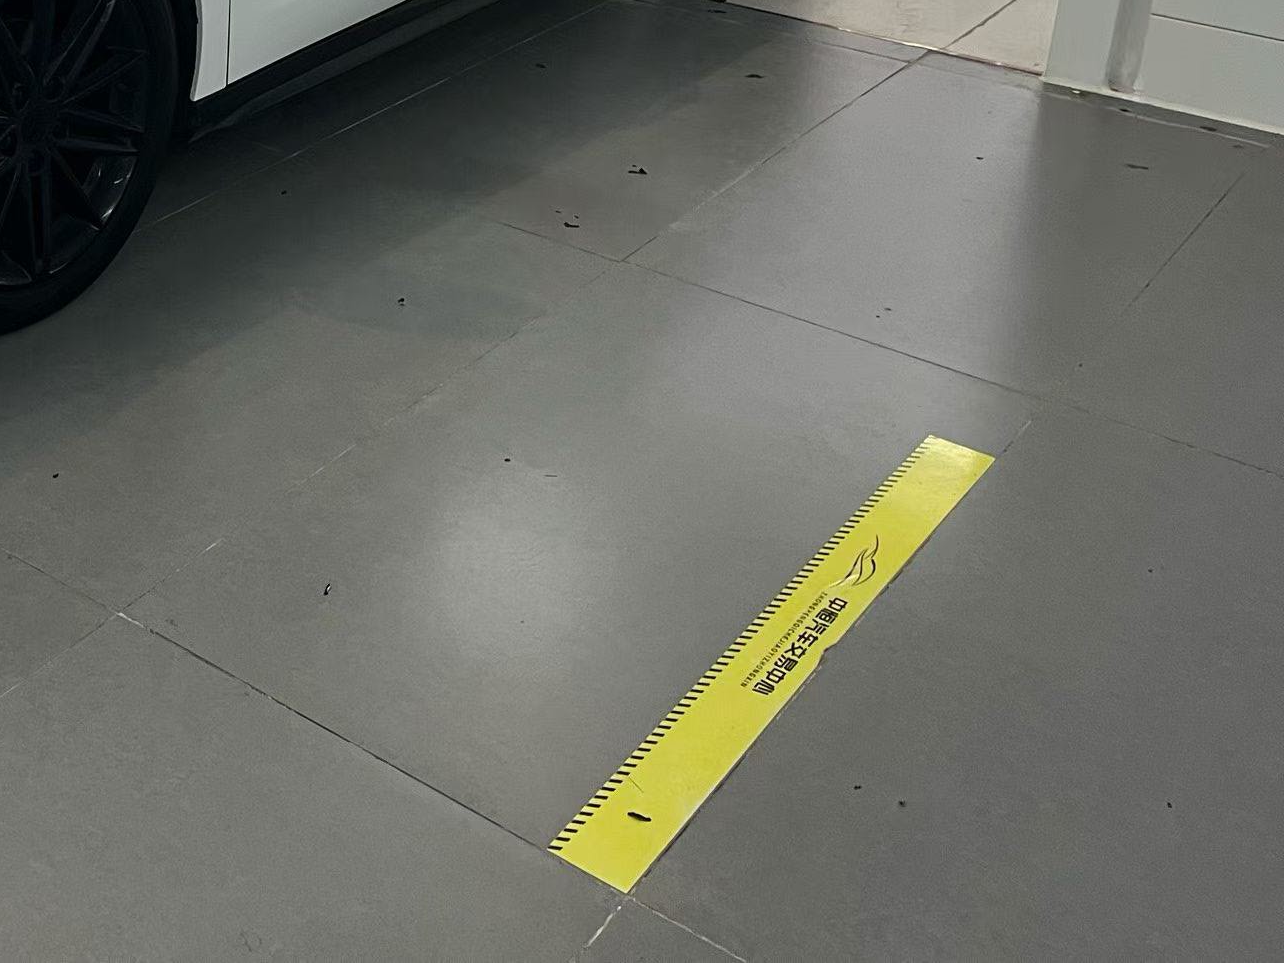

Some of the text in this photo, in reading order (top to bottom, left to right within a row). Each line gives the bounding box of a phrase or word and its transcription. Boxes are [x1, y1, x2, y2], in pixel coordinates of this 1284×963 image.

[752, 597, 848, 695] 中恒汽车交易中心
